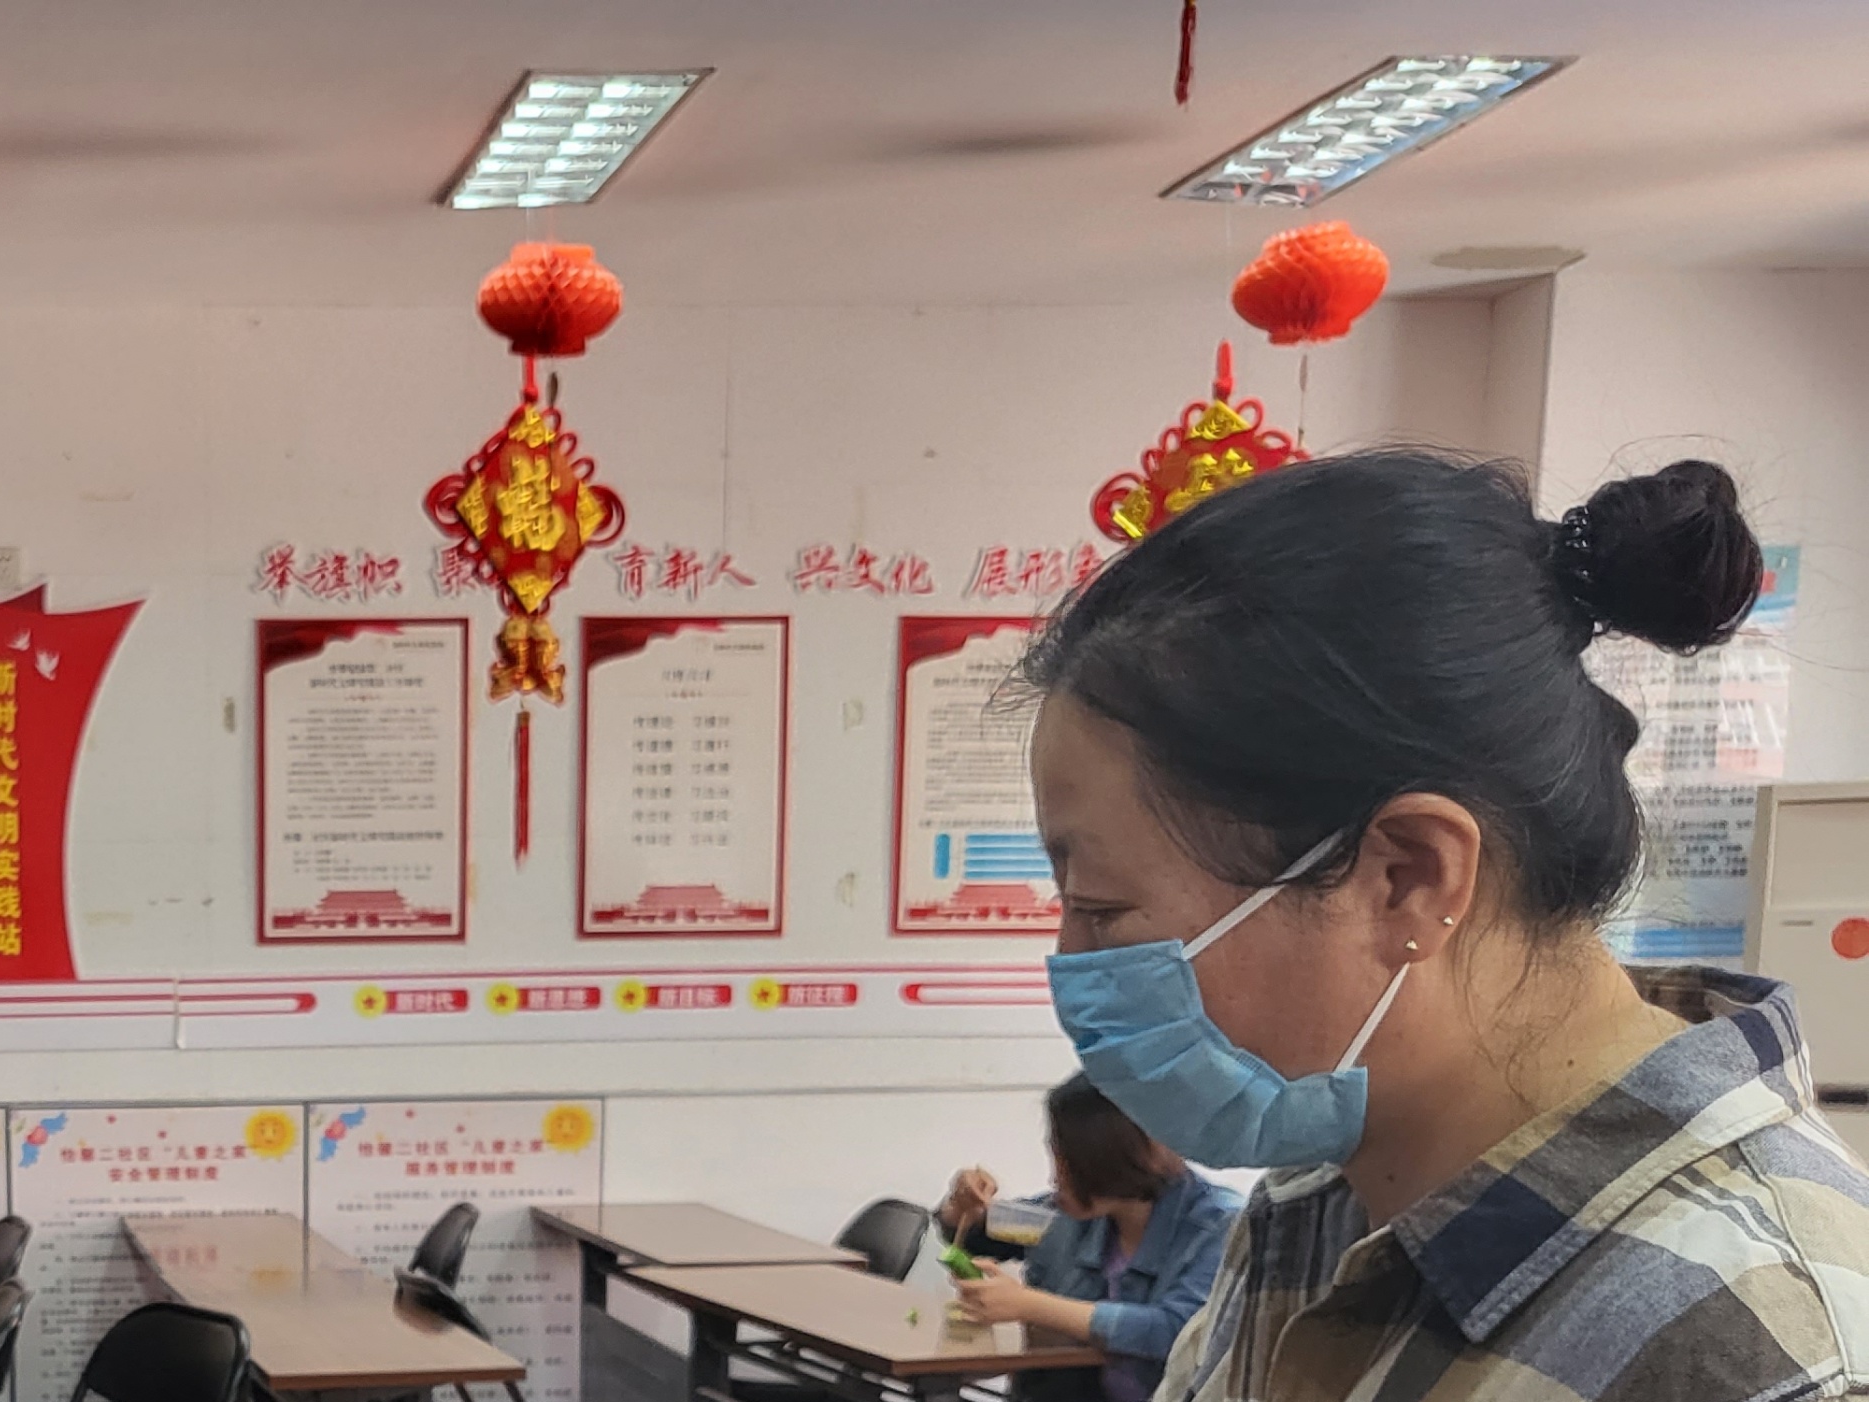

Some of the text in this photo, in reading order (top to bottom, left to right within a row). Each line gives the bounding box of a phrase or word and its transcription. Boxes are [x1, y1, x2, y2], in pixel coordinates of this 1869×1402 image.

[261, 543, 402, 599] 举旗帜
[613, 545, 756, 599] 育新人
[793, 544, 935, 595] 兴文化
